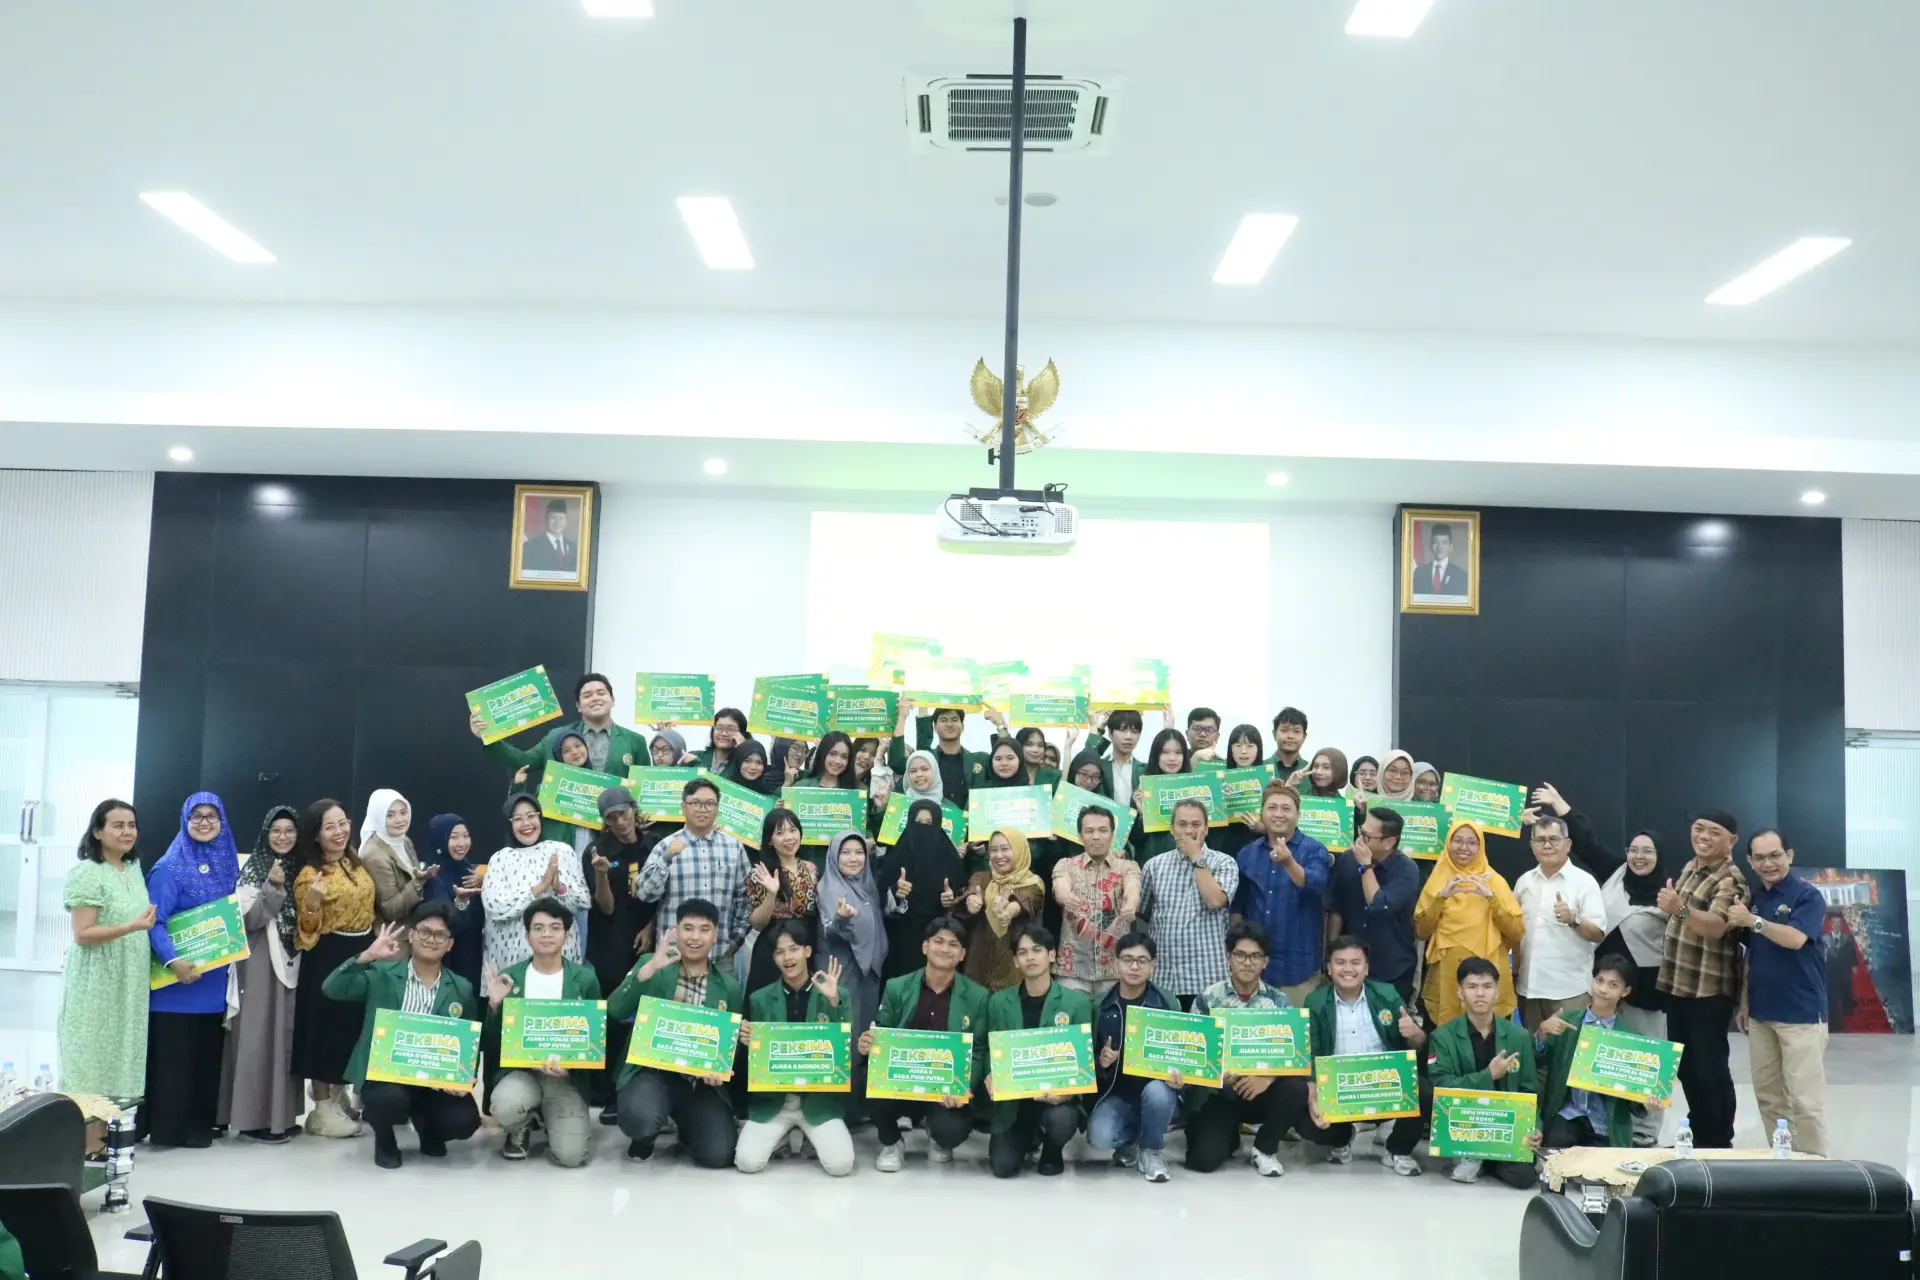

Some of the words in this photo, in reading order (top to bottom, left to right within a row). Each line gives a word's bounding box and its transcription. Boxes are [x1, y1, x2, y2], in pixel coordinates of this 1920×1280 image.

[837, 697, 886, 709] PEKSIMA
[560, 778, 607, 796] PEKSIM
[799, 803, 852, 815] PEKSIMA
[524, 1016, 589, 1030] PEKSIMA
[656, 1017, 719, 1040] PEKSIMA
[1145, 1027, 1206, 1046] PEKSIMA
[1231, 1024, 1293, 1039] PEKSIMA
[396, 1030, 460, 1049] PEKSIMA
[769, 1040, 833, 1054] PEKSIMA
[394, 1050, 415, 1058] JUARA
[420, 1053, 440, 1061] VOKAL
[689, 1048, 709, 1057] PUTRA
[890, 1047, 953, 1063] PEKSIMA
[1011, 1042, 1075, 1061] PEKSIMA
[1595, 1044, 1660, 1067] PEKSIMA
[421, 1059, 441, 1067] PUTRA
[1180, 1057, 1199, 1065] PUTRA
[1337, 1069, 1400, 1086] PEKSIMA
[1596, 1062, 1615, 1071] JUARA
[1619, 1067, 1638, 1075] VOKAL
[1639, 1071, 1655, 1079] SOLO
[1628, 1075, 1648, 1084] PUTRA
[1449, 1127, 1513, 1143] PEKSIMA
